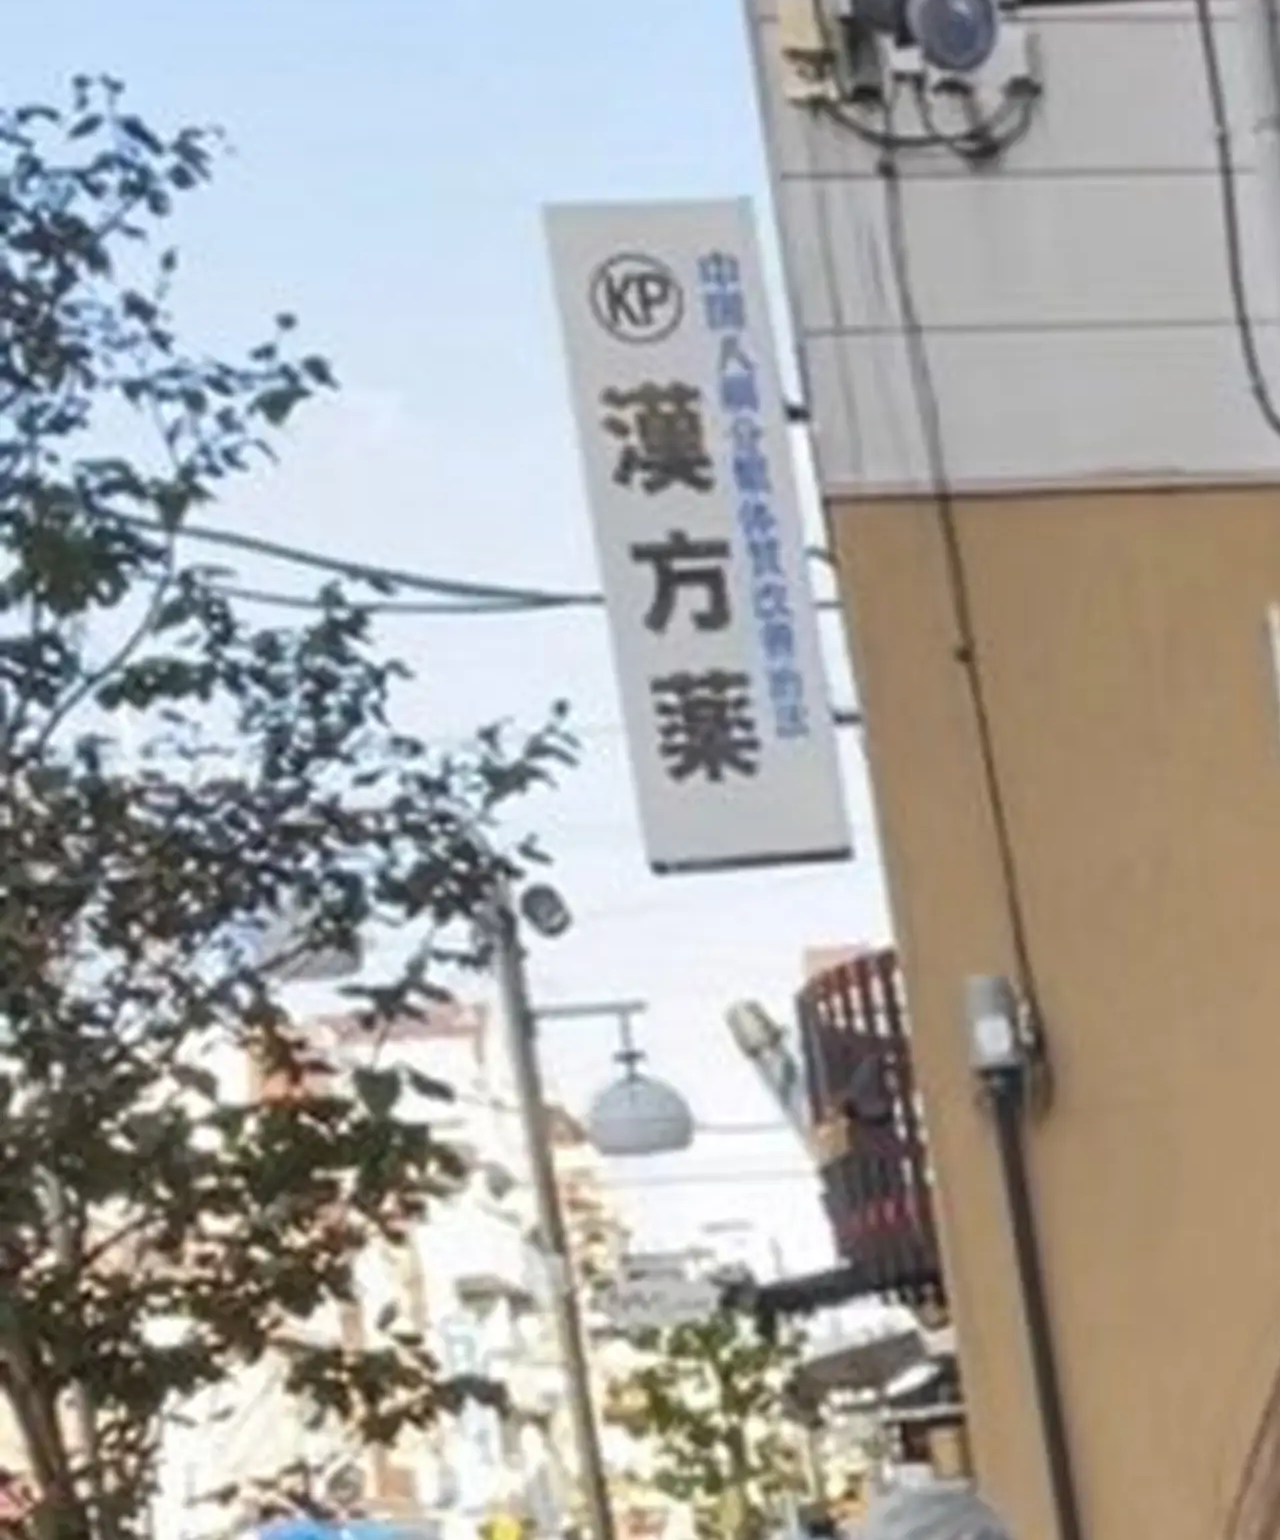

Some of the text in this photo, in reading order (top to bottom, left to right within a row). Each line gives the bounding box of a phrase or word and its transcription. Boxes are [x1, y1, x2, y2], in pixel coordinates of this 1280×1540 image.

[604, 271, 670, 327] KP
[600, 380, 762, 783] 漢方薬
